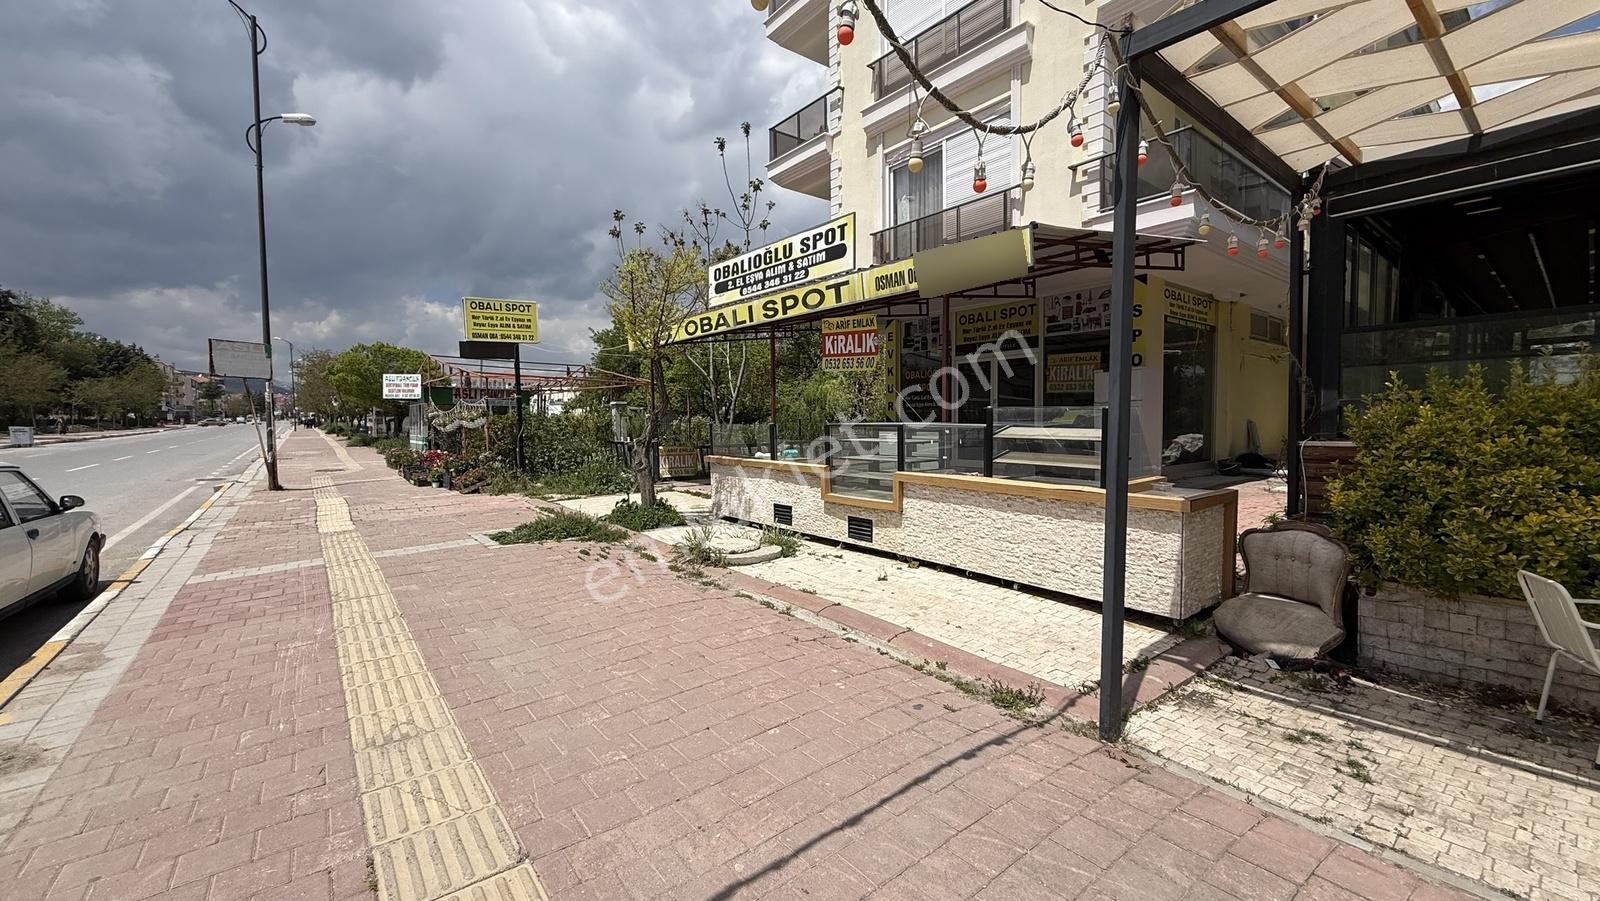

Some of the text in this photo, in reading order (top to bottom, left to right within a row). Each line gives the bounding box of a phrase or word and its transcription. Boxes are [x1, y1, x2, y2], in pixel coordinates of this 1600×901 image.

[714, 223, 848, 282] OBALIOĞLU SPOT
[728, 251, 826, 289] 2. EL EŞYA ALIM & SATIM
[875, 270, 906, 292] OSMAN
[742, 283, 762, 295] 0544
[783, 275, 792, 283] 31
[794, 270, 806, 279] 22
[470, 301, 532, 313] OBALI SPOT
[684, 280, 850, 336] OBALI SPOT
[1164, 288, 1190, 304] OBALI
[1192, 296, 1212, 310] SPOT
[853, 318, 875, 328] EMLAK
[959, 304, 1036, 325] OBALI SPOT
[825, 357, 875, 369] 0532 653 56 00
